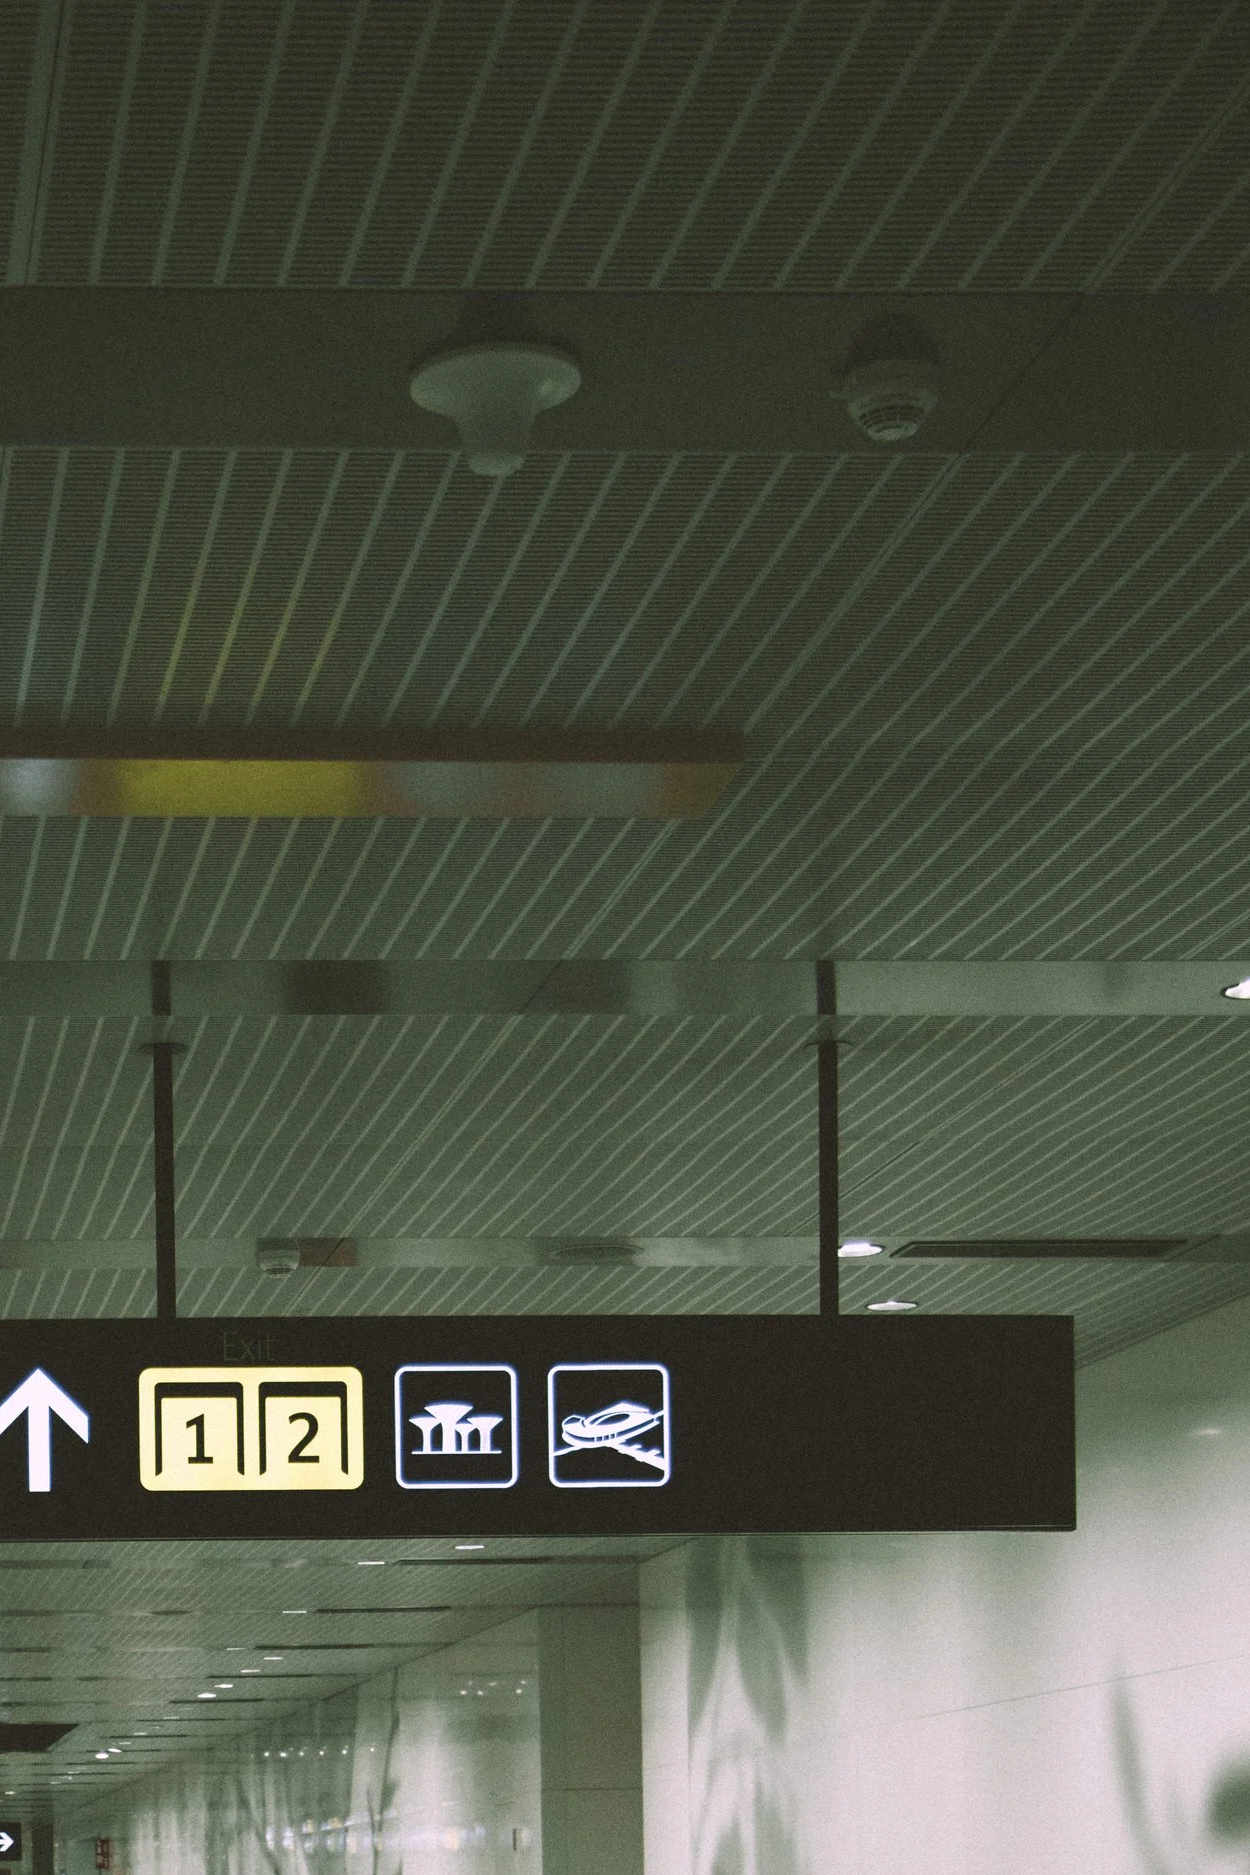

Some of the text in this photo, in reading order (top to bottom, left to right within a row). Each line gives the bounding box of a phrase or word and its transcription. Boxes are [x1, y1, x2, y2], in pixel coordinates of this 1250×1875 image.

[222, 1330, 276, 1362] Exit
[185, 1411, 320, 1465] 1 2
